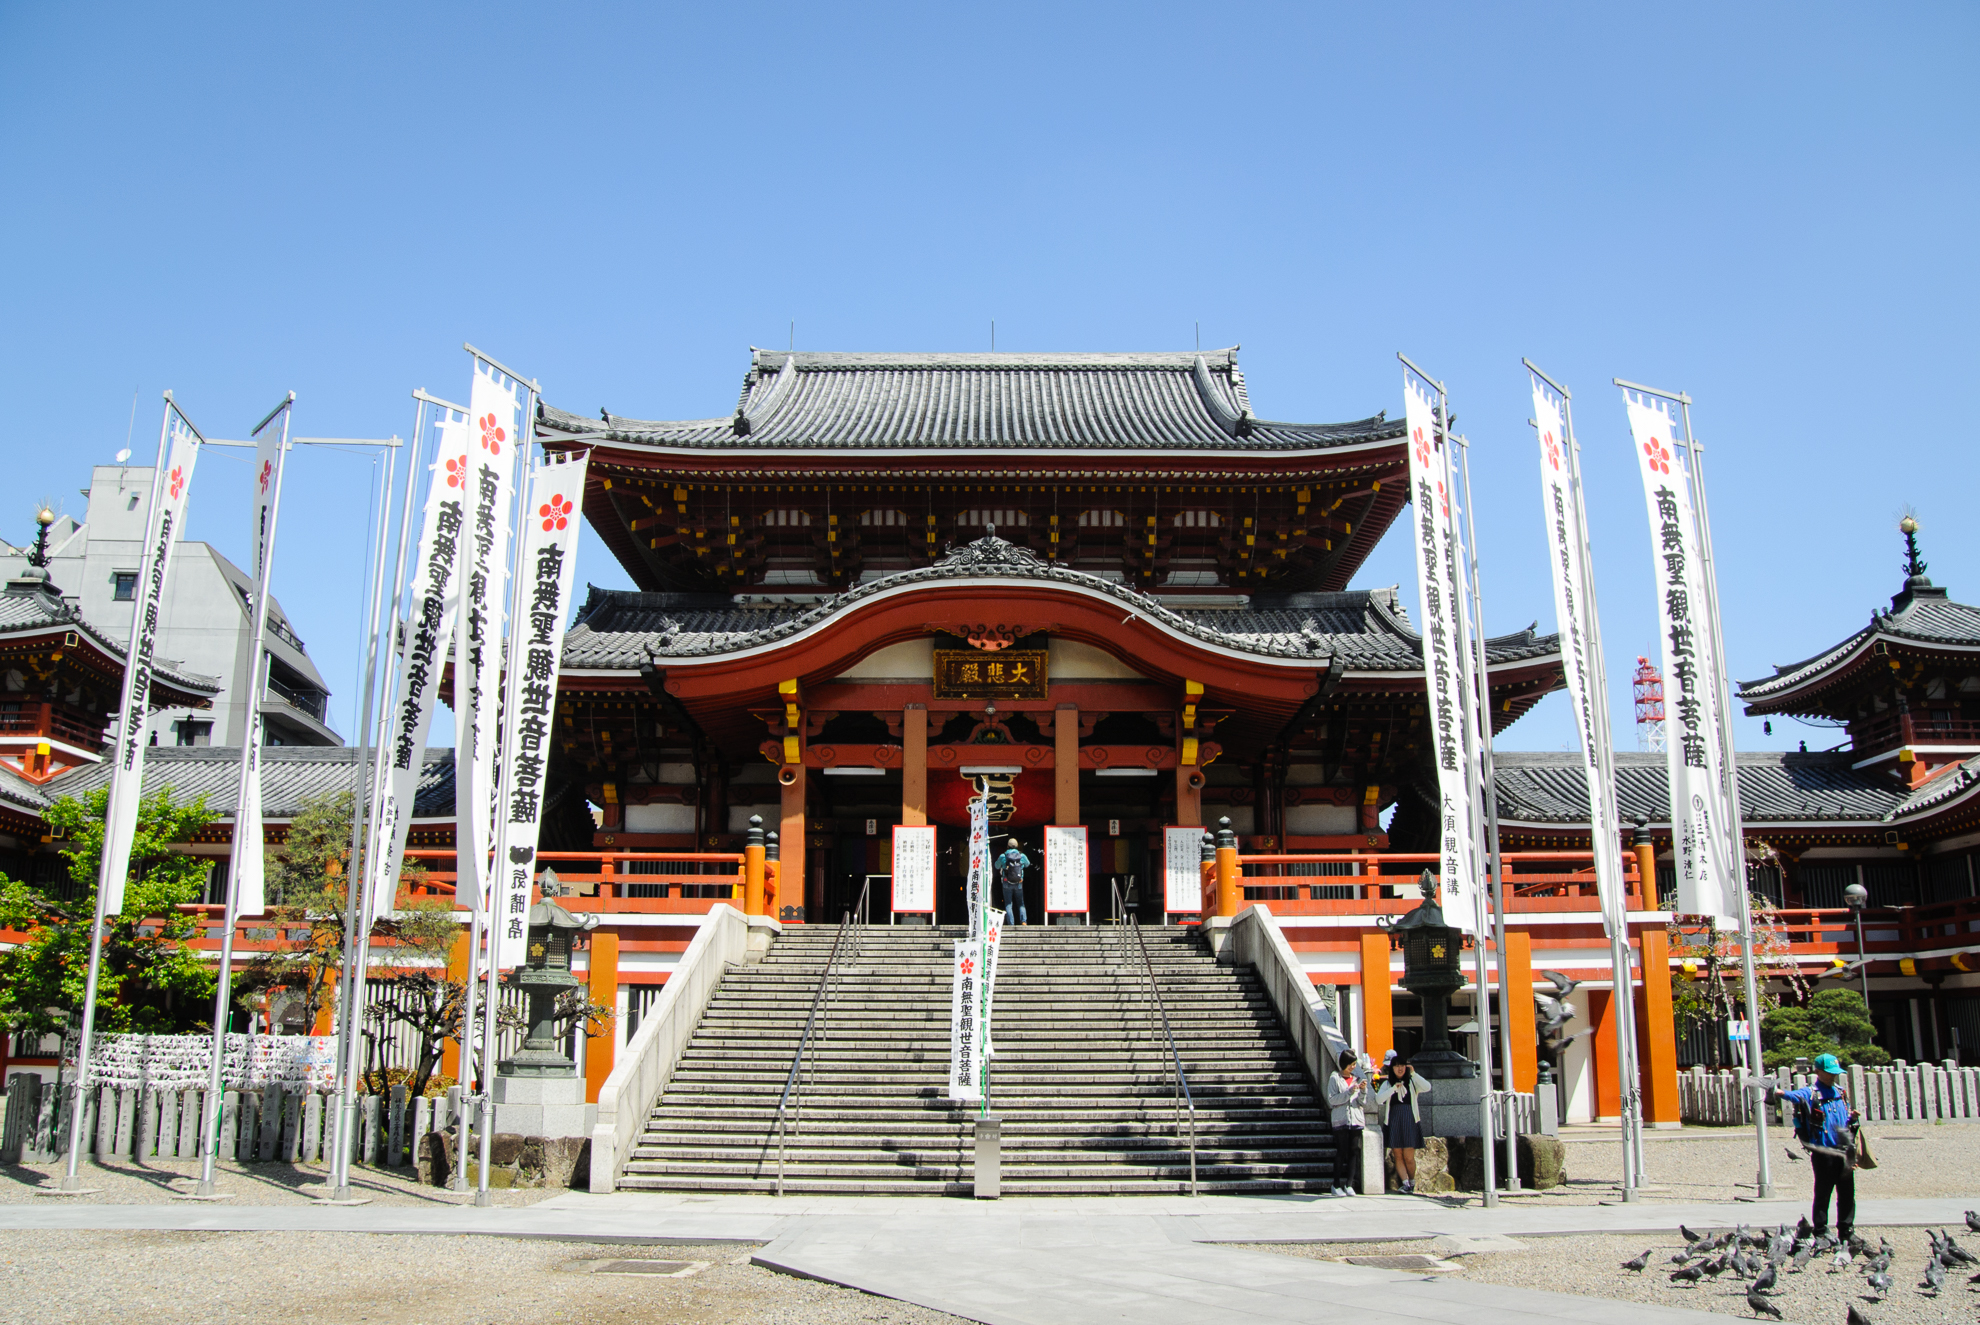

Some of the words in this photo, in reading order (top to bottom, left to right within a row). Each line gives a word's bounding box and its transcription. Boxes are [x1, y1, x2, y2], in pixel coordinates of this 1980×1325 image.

[957, 662, 1030, 684] 大悲殿
[1418, 476, 1458, 772] 南無聖観世音菩薩
[1654, 484, 1707, 770] 南無聖観世音菩薩
[1443, 792, 1460, 896] 大須観音講
[957, 976, 974, 1087] 南無聖観世音菩薩
